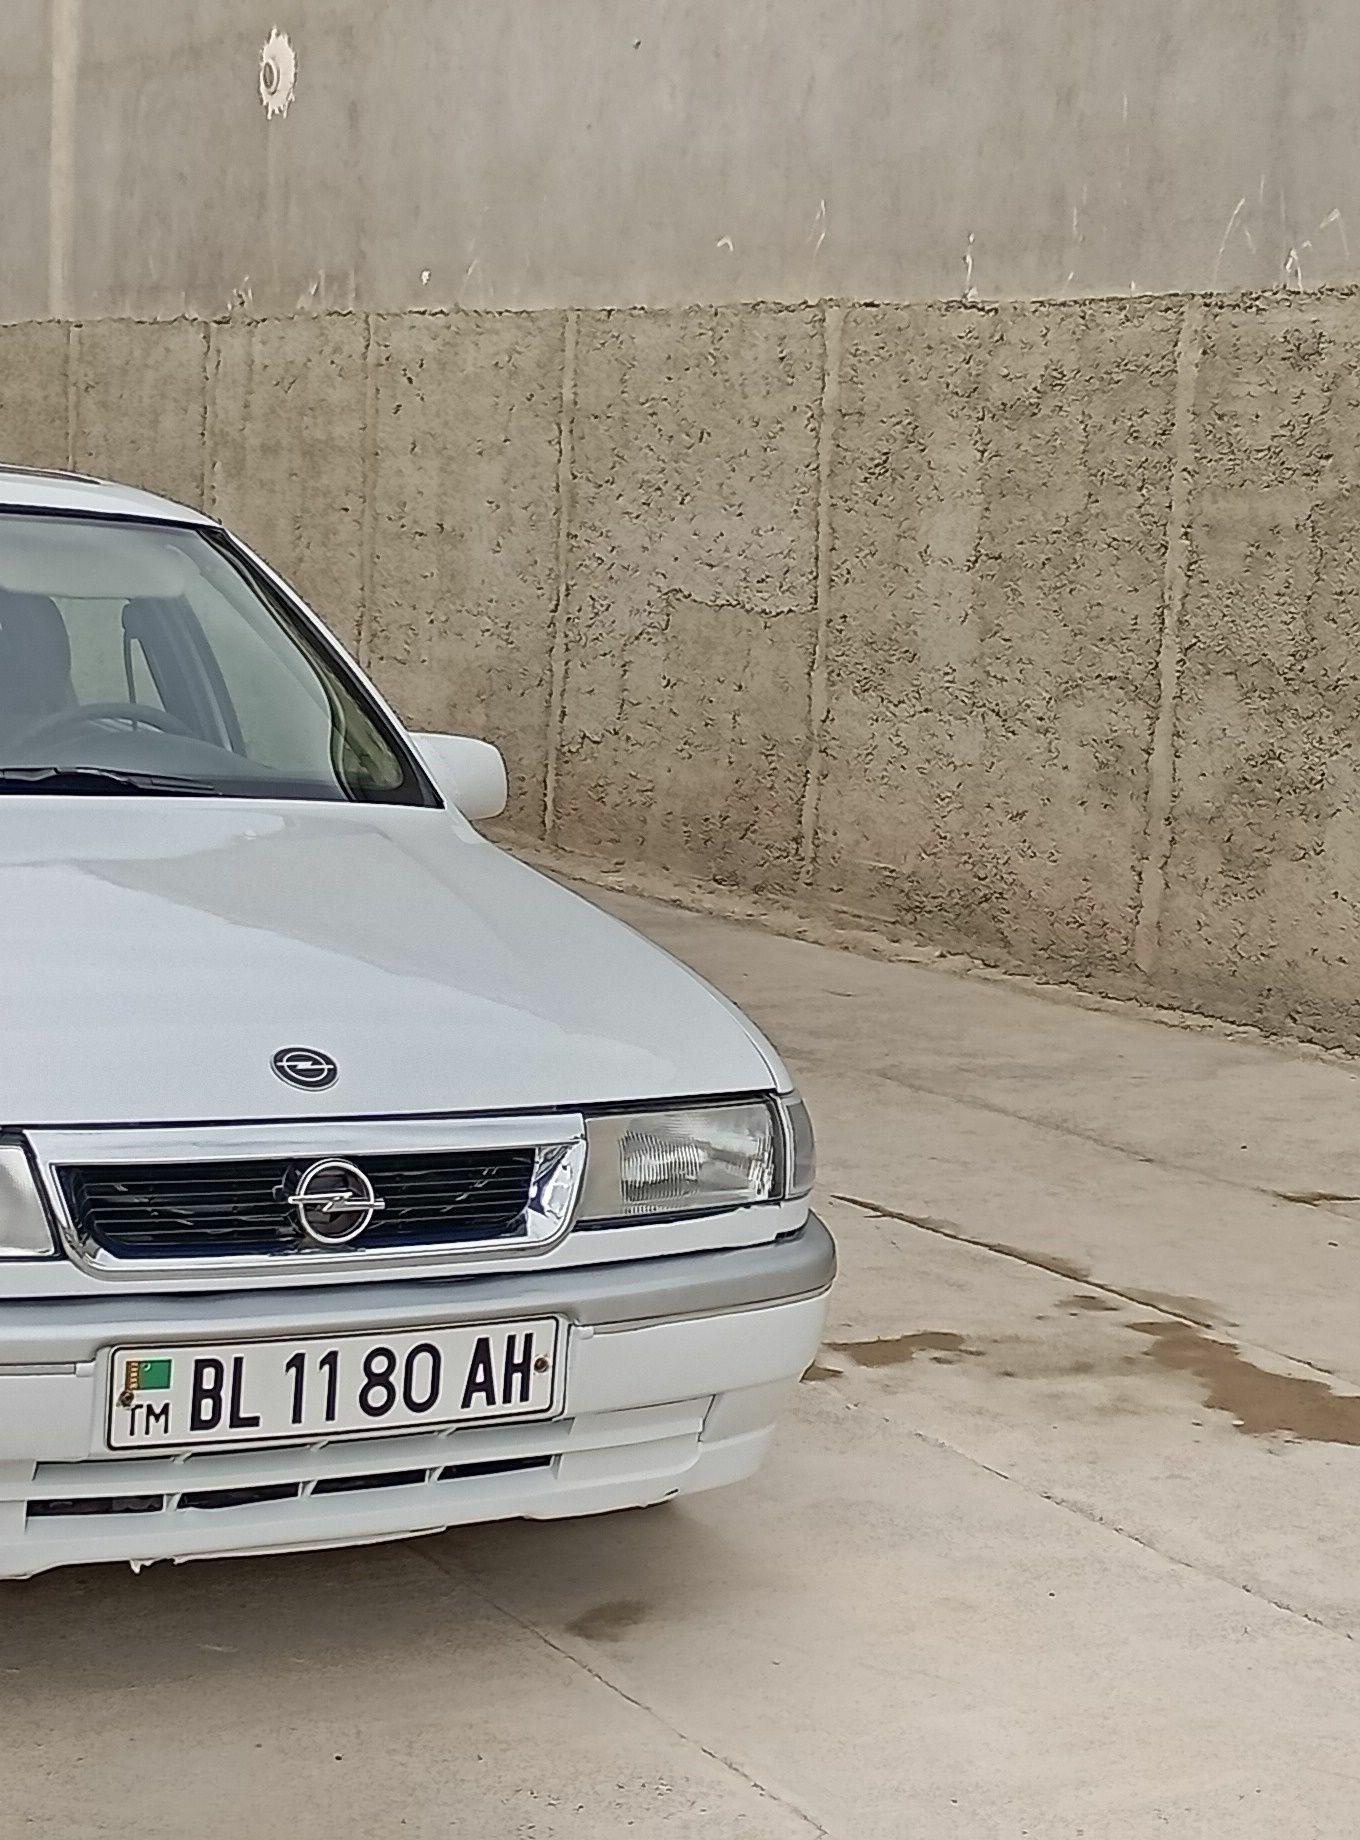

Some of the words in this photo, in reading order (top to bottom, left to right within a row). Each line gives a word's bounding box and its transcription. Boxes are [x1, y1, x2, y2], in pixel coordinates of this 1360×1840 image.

[190, 1356, 261, 1433] BL
[460, 1331, 534, 1410] AH
[128, 1402, 171, 1437] TM
